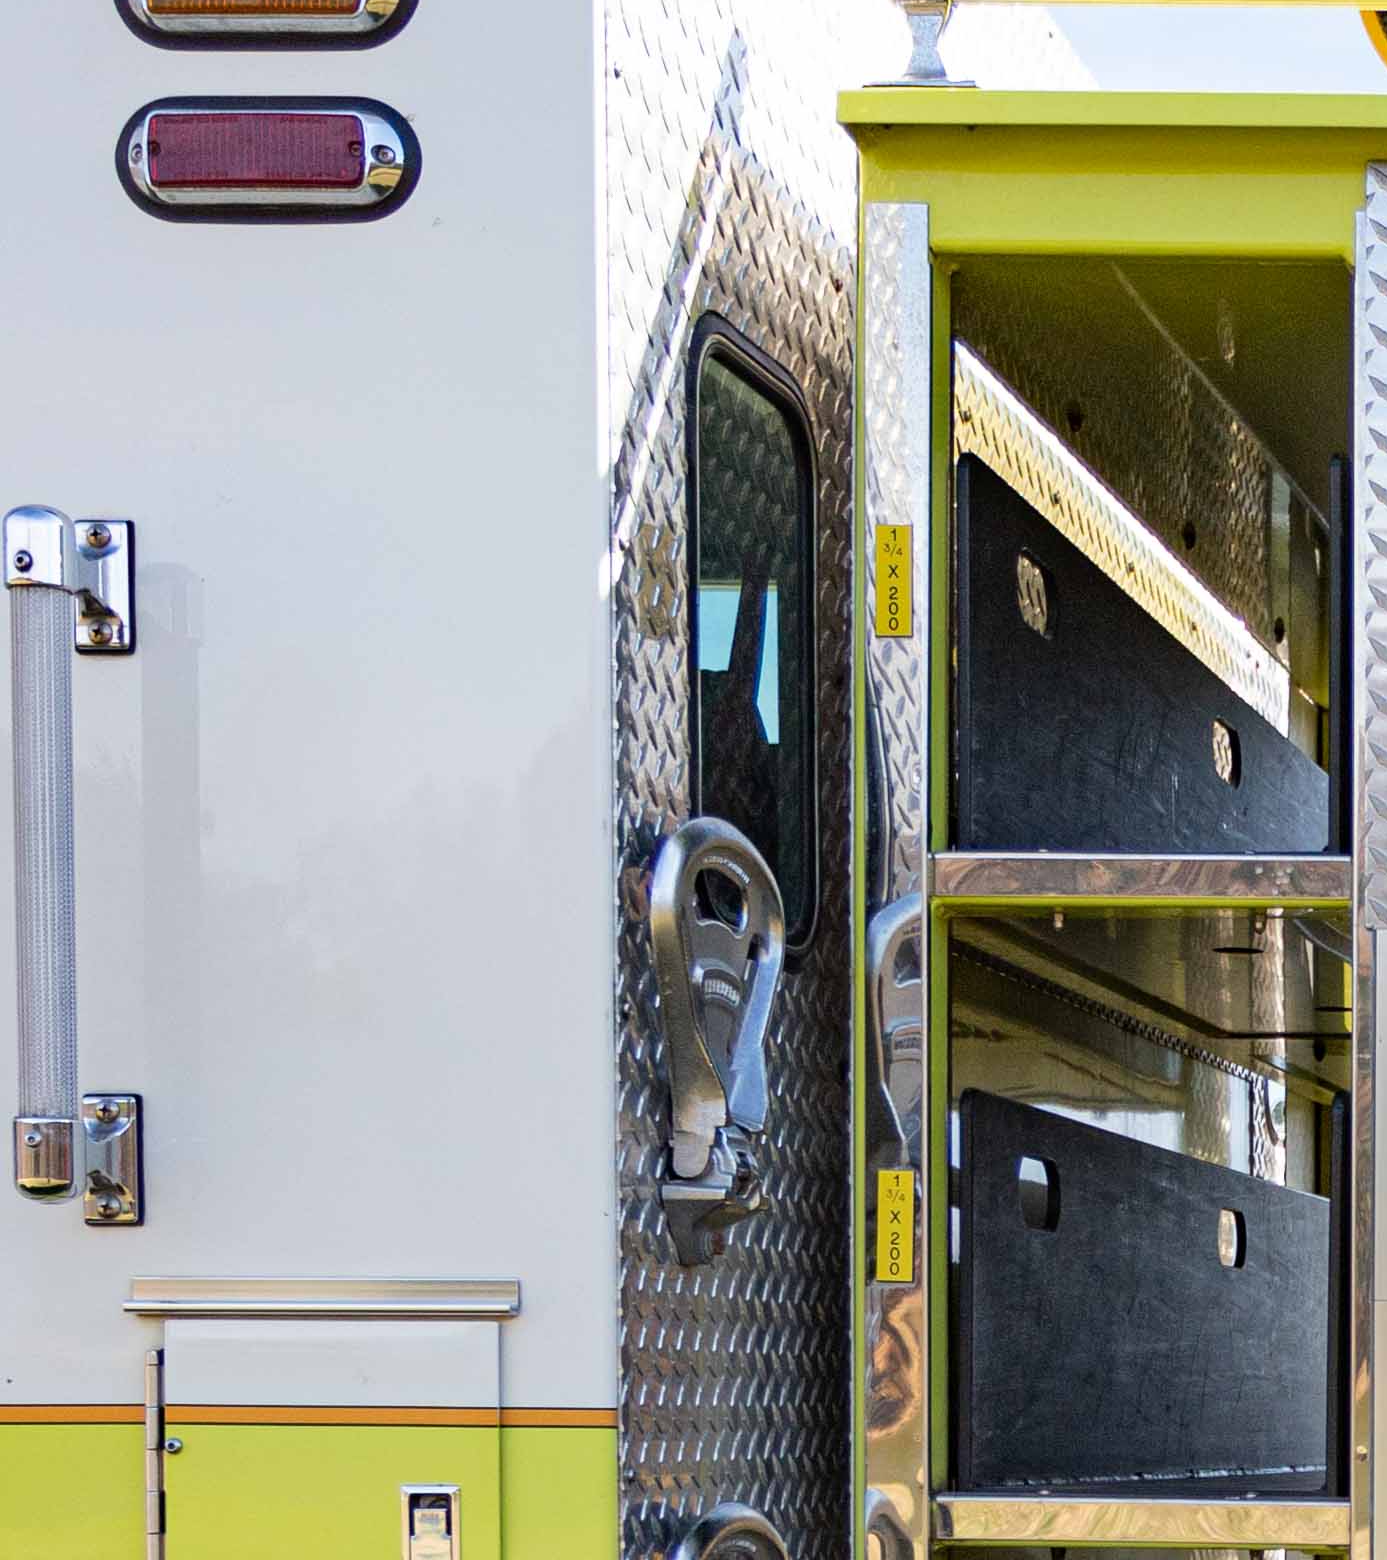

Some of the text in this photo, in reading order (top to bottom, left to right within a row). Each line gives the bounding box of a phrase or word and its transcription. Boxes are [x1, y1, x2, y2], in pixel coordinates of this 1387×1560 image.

[883, 543, 902, 556] 3/4
[888, 564, 899, 578] X
[890, 1210, 901, 1224] X
